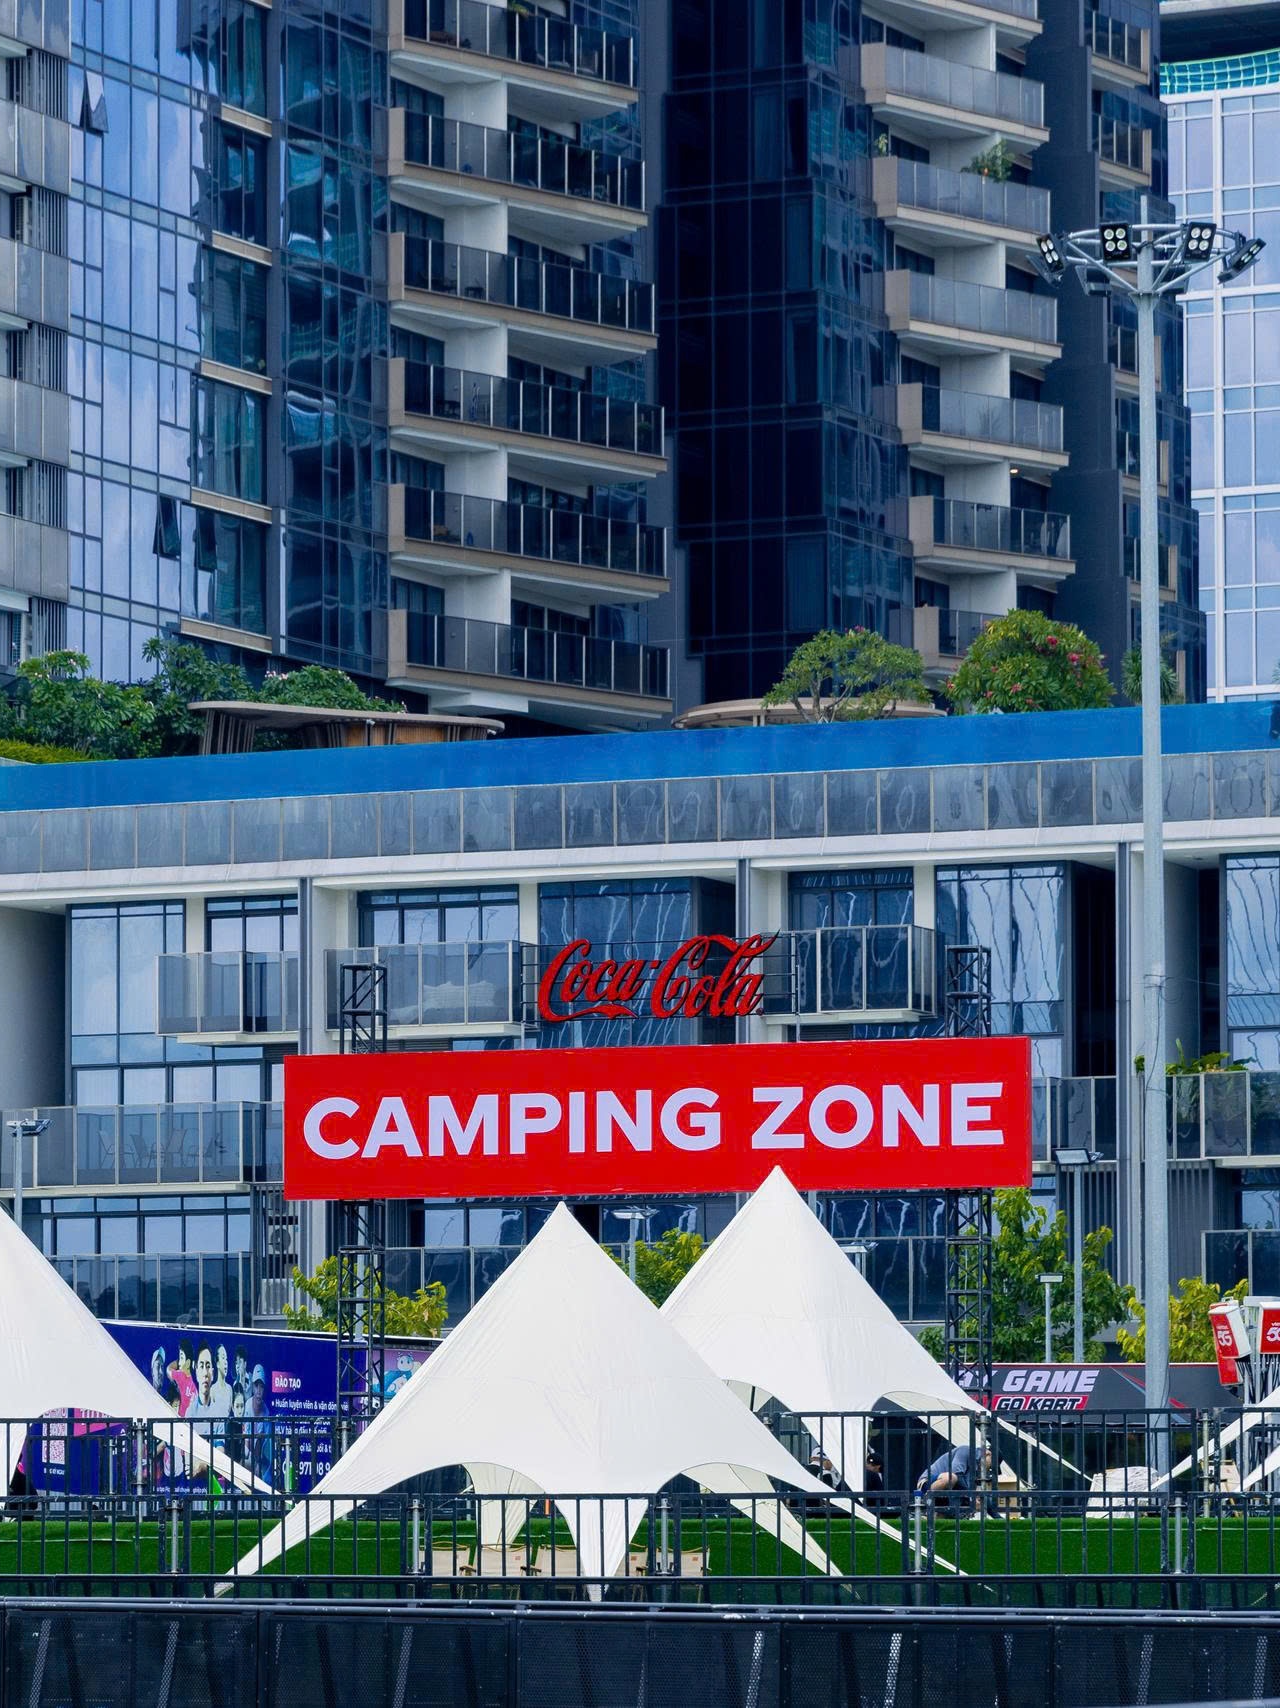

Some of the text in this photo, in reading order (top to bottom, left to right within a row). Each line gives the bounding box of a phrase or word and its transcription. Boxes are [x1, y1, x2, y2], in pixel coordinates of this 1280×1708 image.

[538, 929, 780, 1022] Coca-Cola
[303, 1082, 1005, 1160] CAMPING ZONE
[1217, 1330, 1233, 1346] 5G
[275, 1374, 301, 1391] ĐÀO TẠO
[1002, 1369, 1100, 1393] GAME
[994, 1396, 1026, 1411] GO
[1026, 1396, 1083, 1411] KART
